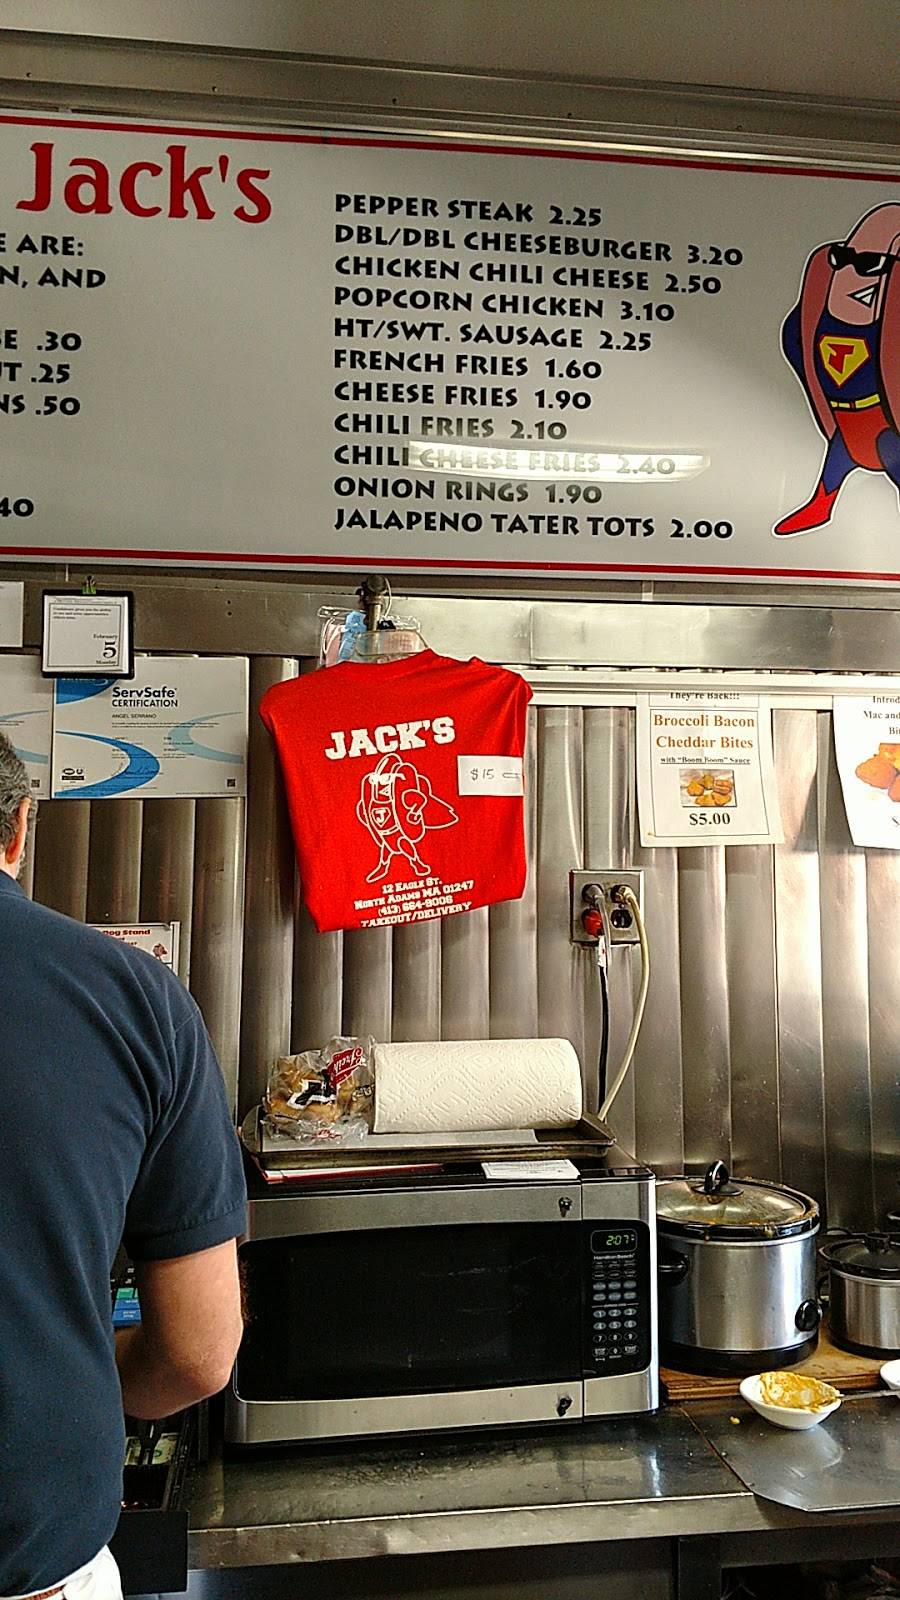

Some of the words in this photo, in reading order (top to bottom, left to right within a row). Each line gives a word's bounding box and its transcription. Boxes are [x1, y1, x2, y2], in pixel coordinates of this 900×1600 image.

[15, 141, 272, 223] Jack's
[335, 194, 439, 217] PEPPER
[447, 200, 533, 222] STEAK
[549, 205, 601, 227] 2.25
[16, 234, 83, 256] ARE:
[335, 224, 455, 249] DBL/DBL
[463, 231, 672, 262] CHEESEBURGER
[687, 244, 743, 266] 3.20
[38, 266, 106, 288] AND
[335, 256, 460, 280] CHICKEN
[469, 262, 543, 284] CHILI
[553, 267, 649, 290] CHEESE
[665, 273, 722, 294] 2.50
[334, 286, 472, 312] POPCORN
[482, 294, 603, 318] CHICKEN
[620, 301, 675, 321] 3.10
[36, 331, 82, 351] .30
[334, 317, 450, 342] HT/SWT.
[460, 323, 583, 348] SAUSAGE
[599, 330, 651, 351] 2.25
[31, 363, 70, 384] .25
[334, 349, 444, 372] FRENCH
[456, 354, 528, 376] FRIES
[545, 358, 602, 379] 1.60
[35, 396, 80, 416] .50
[334, 381, 434, 404] CHEESE
[445, 386, 518, 408] FRIES
[535, 389, 592, 410] 1.90
[334, 413, 409, 435] CHILI
[421, 416, 494, 438] FRIES
[510, 419, 567, 440] 2.10
[334, 445, 409, 466] CHILI
[419, 448, 518, 469] CHEESE
[528, 452, 600, 473] FRIES
[616, 455, 675, 475] 2.40
[334, 477, 435, 500] ONION
[446, 481, 528, 503] RINGS
[545, 483, 602, 504] 1.90
[334, 509, 482, 532] JALAPENO
[491, 514, 579, 535] TATER
[587, 516, 655, 537] TOTS
[670, 519, 733, 539] 2.00
[103, 641, 117, 659] 5
[112, 686, 177, 698] ServSafe
[670, 692, 704, 701] They're
[707, 692, 740, 700] Back!!!
[112, 699, 178, 708] CERTIFICATION
[654, 714, 709, 726] Broccoli
[714, 715, 755, 727] Bacon
[863, 710, 883, 719] Mac
[325, 716, 455, 760] JACK'S
[656, 736, 716, 748] Cheddar
[721, 736, 753, 748] Bites
[689, 813, 731, 825] $5.00
[382, 884, 394, 894] 12
[421, 887, 441, 898] MA
[443, 880, 474, 894] 01247
[378, 904, 401, 917] (413)
[606, 1234, 629, 1246] 2:07
